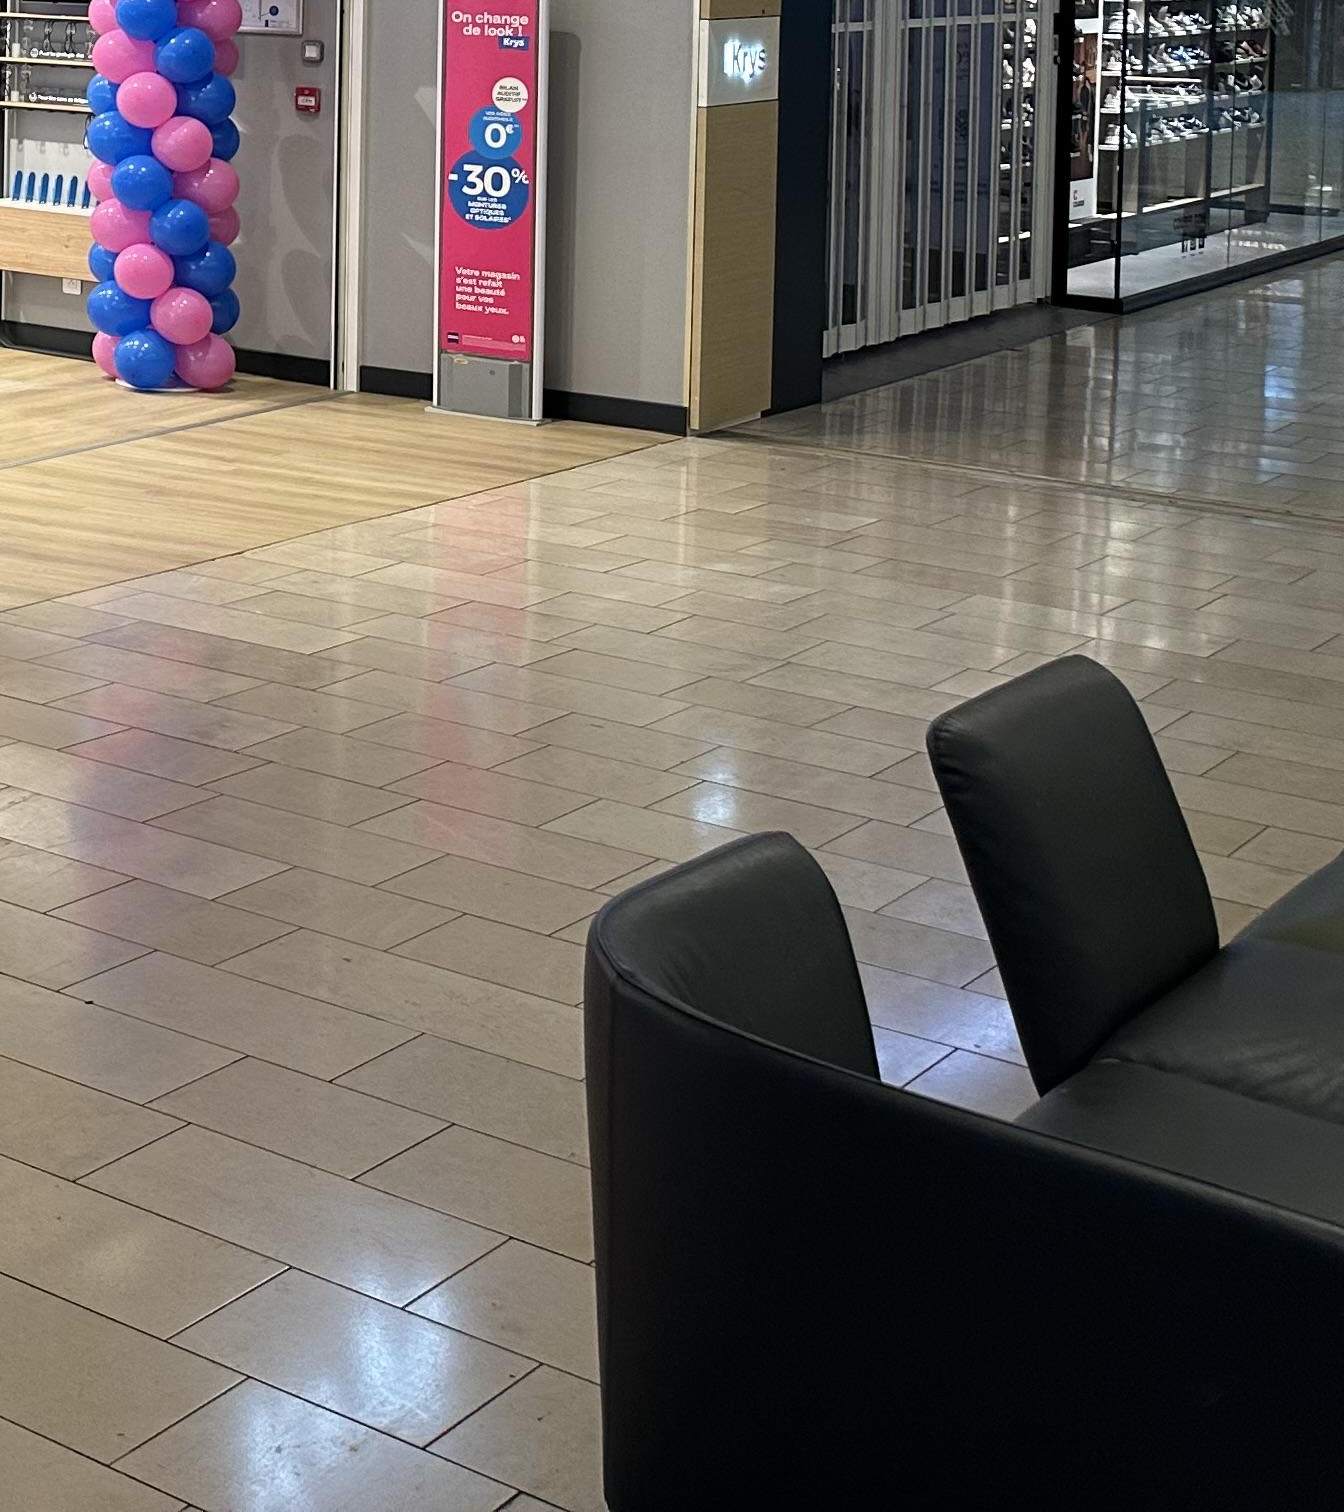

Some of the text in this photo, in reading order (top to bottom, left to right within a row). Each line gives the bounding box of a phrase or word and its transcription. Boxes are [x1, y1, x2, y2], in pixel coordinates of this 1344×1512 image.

[451, 11, 529, 27] On change
[463, 24, 481, 36] de
[484, 24, 513, 37] look
[502, 37, 525, 48] Krys
[455, 266, 521, 281] Votre magasin
